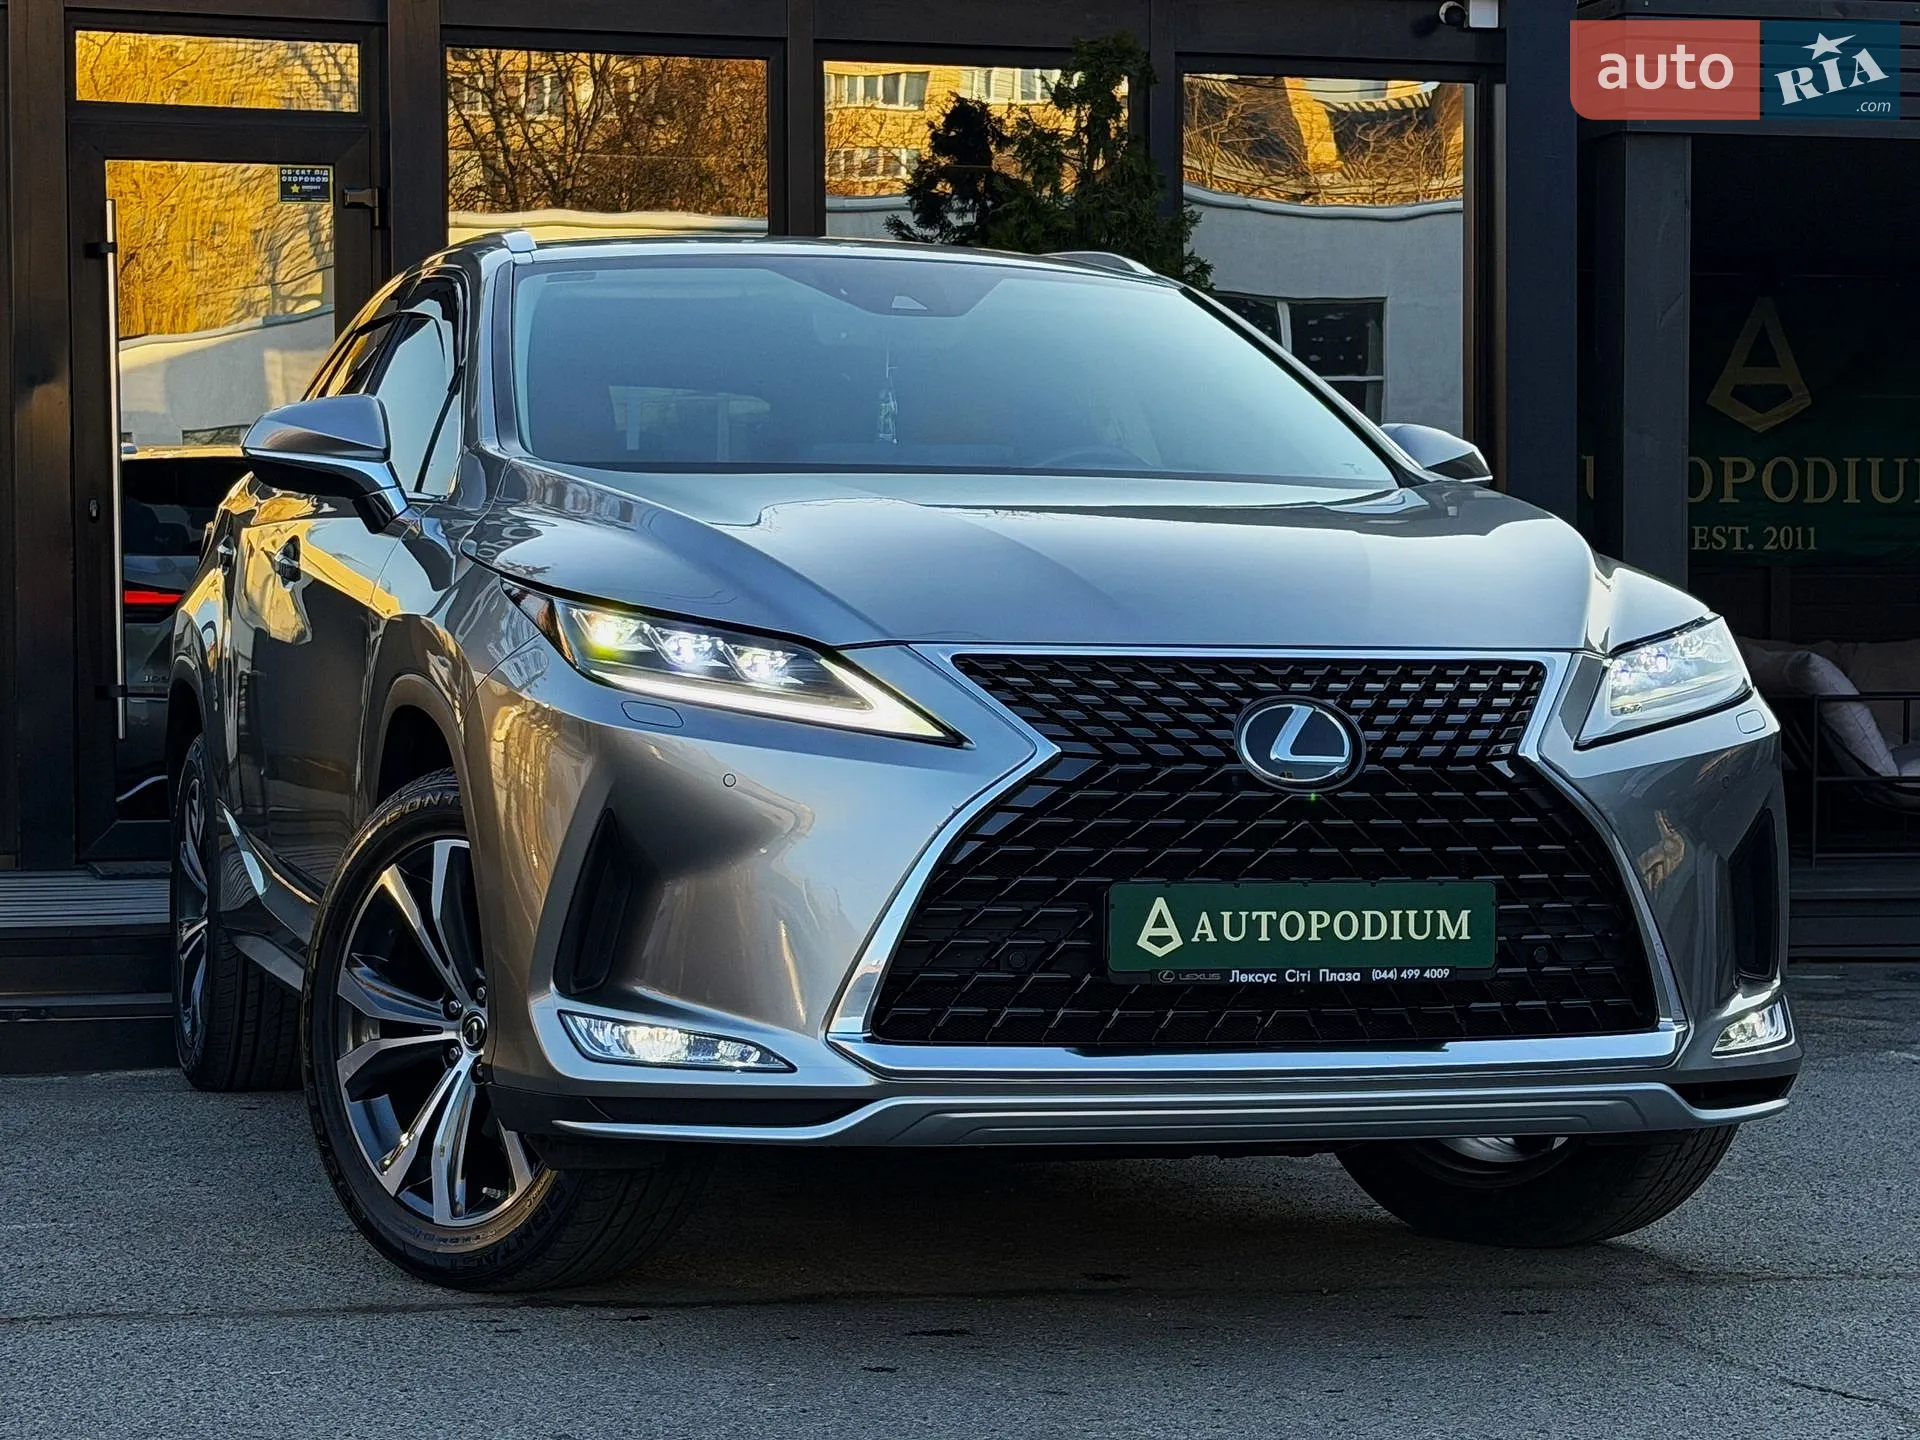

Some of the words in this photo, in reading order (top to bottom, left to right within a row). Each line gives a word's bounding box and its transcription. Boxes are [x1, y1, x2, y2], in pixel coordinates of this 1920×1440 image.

[1692, 526, 1754, 551] EST.
[1763, 526, 1818, 551] 2011
[1191, 910, 1471, 942] AUTOPODIUM
[1179, 973, 1221, 981] LEXUS
[1229, 970, 1277, 984] Лексус
[1319, 969, 1361, 982] Плаза
[1371, 968, 1398, 981] (044)
[1400, 969, 1420, 979] 499
[1423, 968, 1450, 979] 4009
